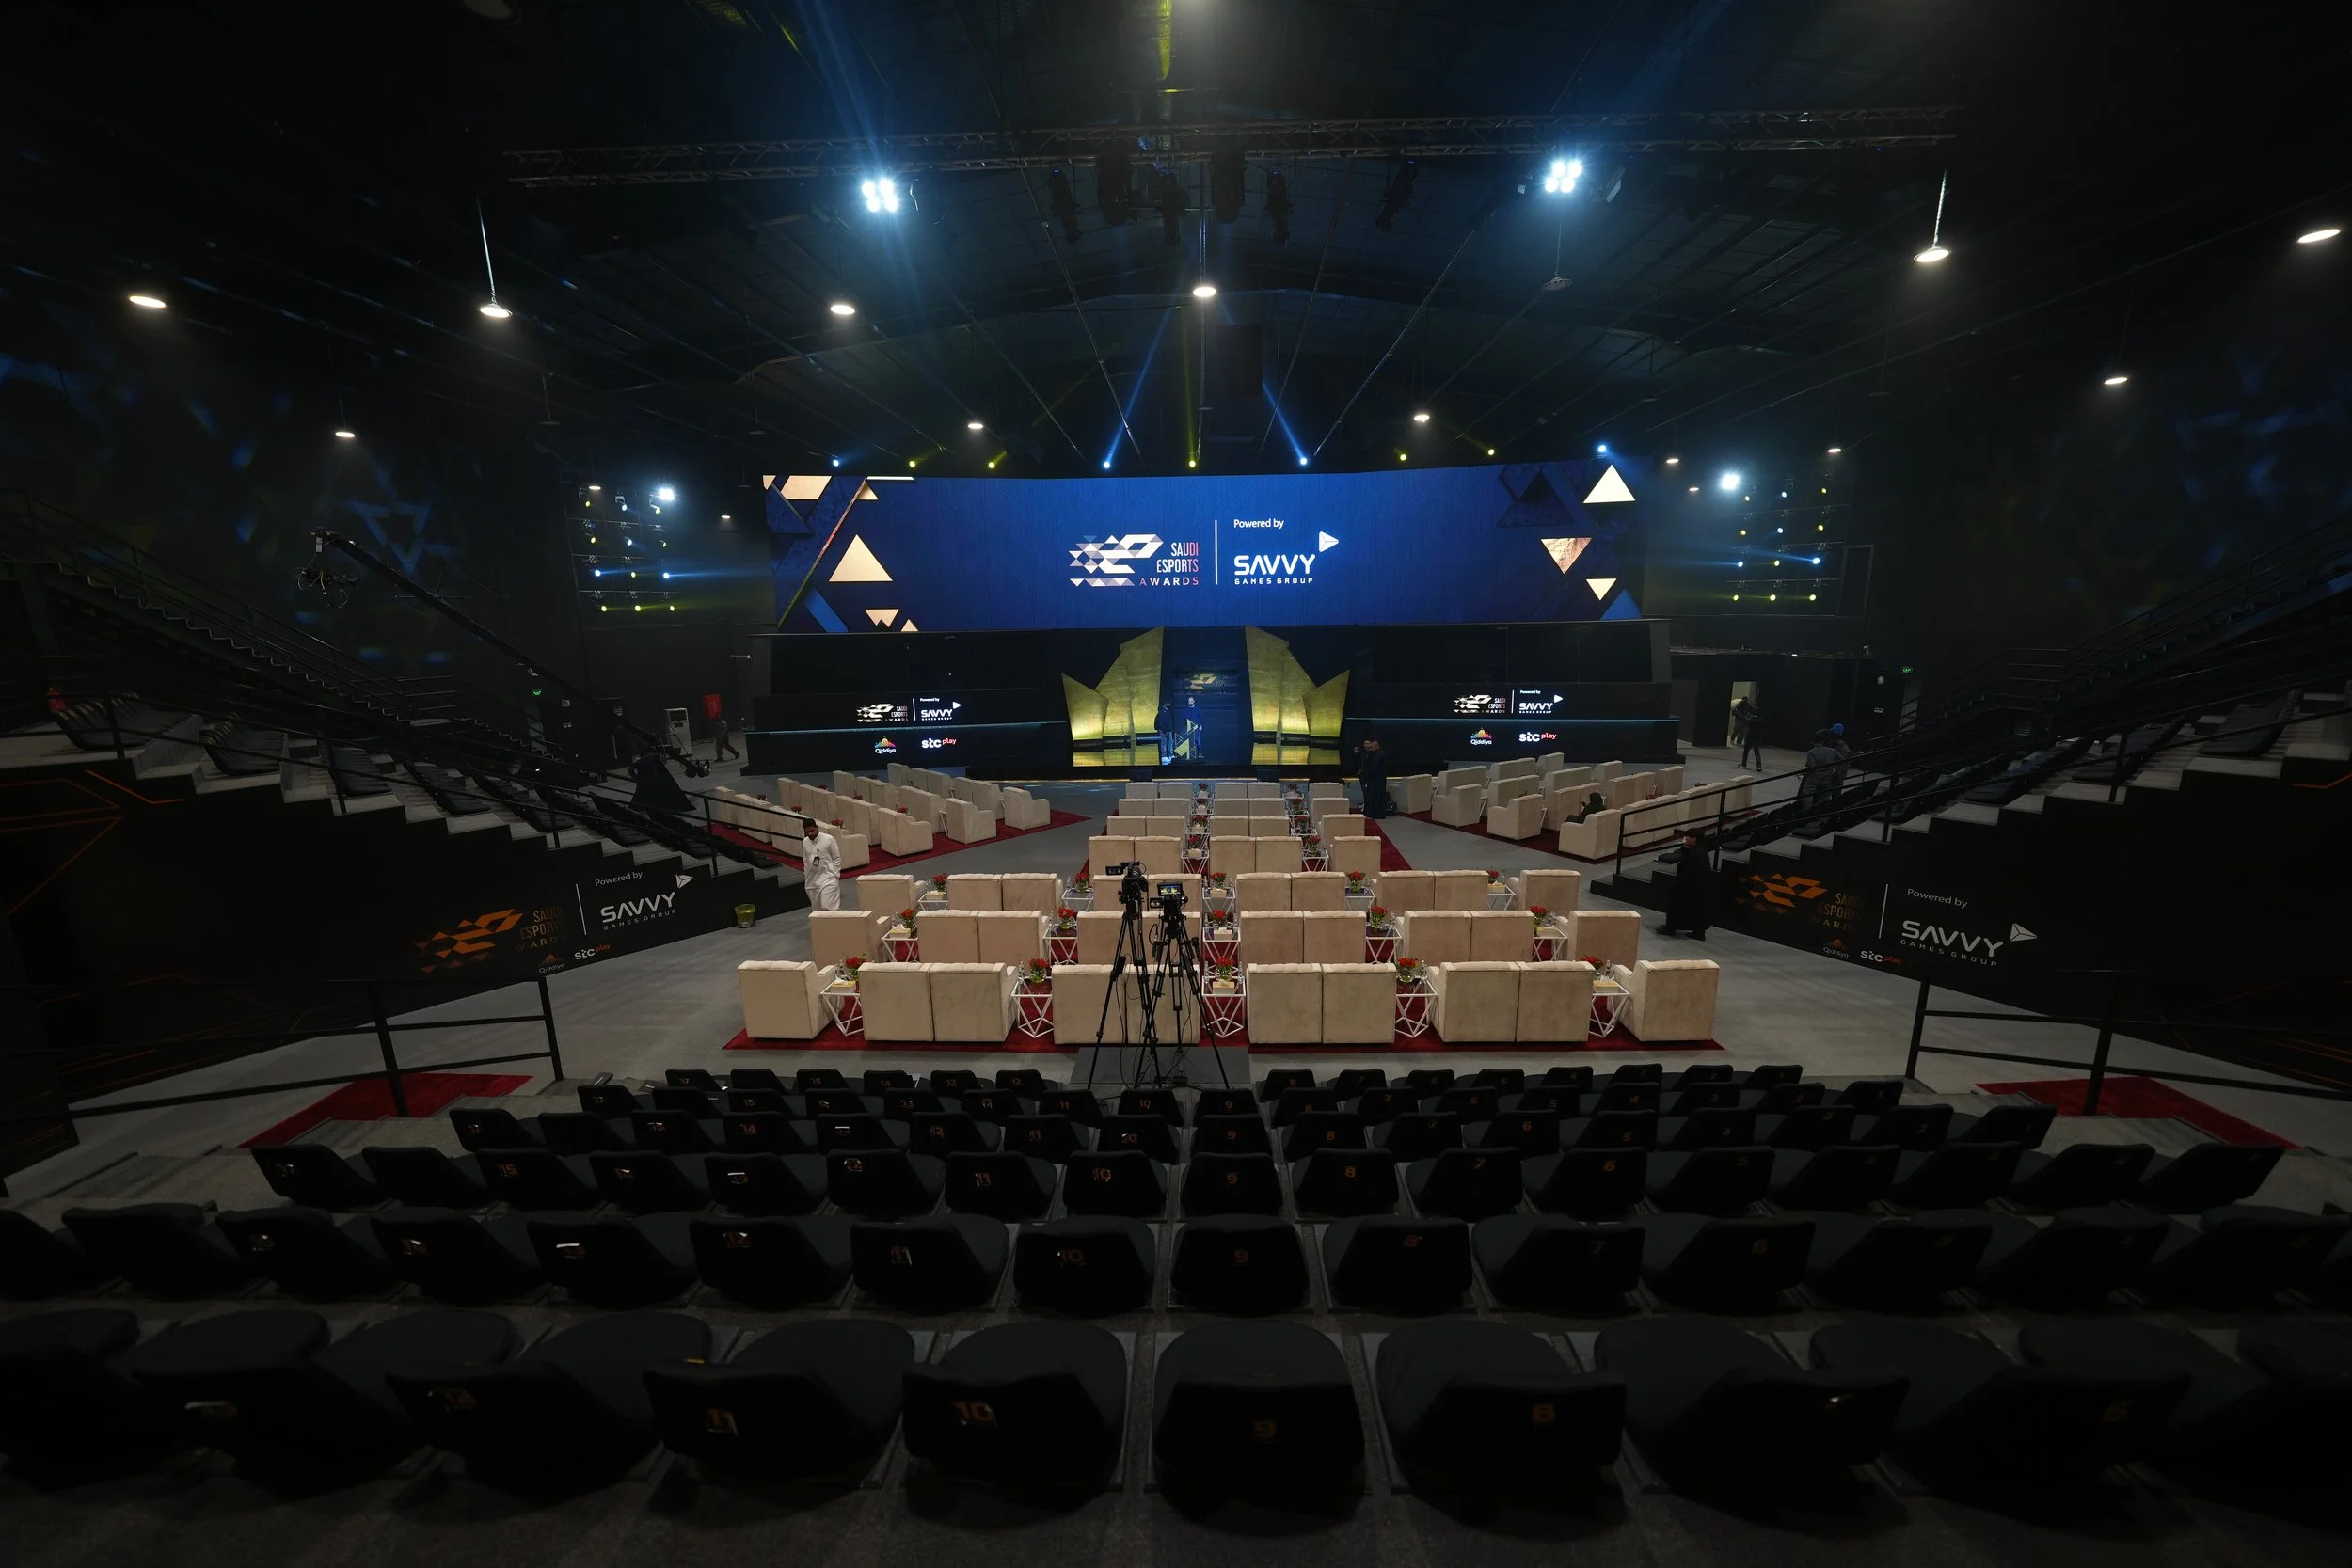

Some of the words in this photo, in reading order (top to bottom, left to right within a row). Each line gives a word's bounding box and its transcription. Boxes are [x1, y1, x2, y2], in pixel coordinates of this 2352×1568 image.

[1233, 518, 1270, 529] Powered
[1273, 518, 1284, 530] by
[1170, 543, 1199, 557] SAUDI
[1156, 559, 1199, 573] ESPORTS
[1234, 554, 1315, 576] SAVVY
[1139, 577, 1200, 586] AWARDS
[920, 709, 953, 718] SAVVY
[921, 738, 942, 749] stc
[1519, 732, 1540, 742] stc
[595, 873, 630, 886] Powered
[632, 871, 643, 879] by
[1907, 888, 1952, 904] Powered
[1955, 897, 1968, 909] by
[600, 892, 675, 923] SAVVY
[1818, 902, 1863, 921] ESPORTS
[603, 918, 639, 931] GAMES
[644, 909, 676, 922] GROUP
[519, 919, 564, 940] ESPORTS
[1901, 920, 2004, 957] SAVVY
[574, 949, 596, 960] stc
[1822, 946, 1849, 958] Qiddiya
[1860, 950, 1883, 963] stc
[1900, 940, 1945, 955] GAMES
[1951, 951, 1997, 967] GROUP
[538, 963, 564, 974] Qiddiya
[1225, 1101, 1232, 1111] 9
[1522, 1121, 1532, 1132] 6
[1227, 1130, 1236, 1142] 9
[1326, 1131, 1336, 1141] 8
[1473, 1157, 1487, 1169] 7
[1604, 1160, 1616, 1172] 6
[1227, 1173, 1238, 1185] 9
[1344, 1167, 1357, 1179] 8
[1591, 1240, 1607, 1254] 7
[1753, 1238, 1769, 1253] 6
[1234, 1248, 1249, 1264] 9
[955, 1400, 996, 1424] 10
[1532, 1402, 1556, 1424] 8
[707, 1408, 739, 1435] 11
[1252, 1418, 1278, 1441] 9
